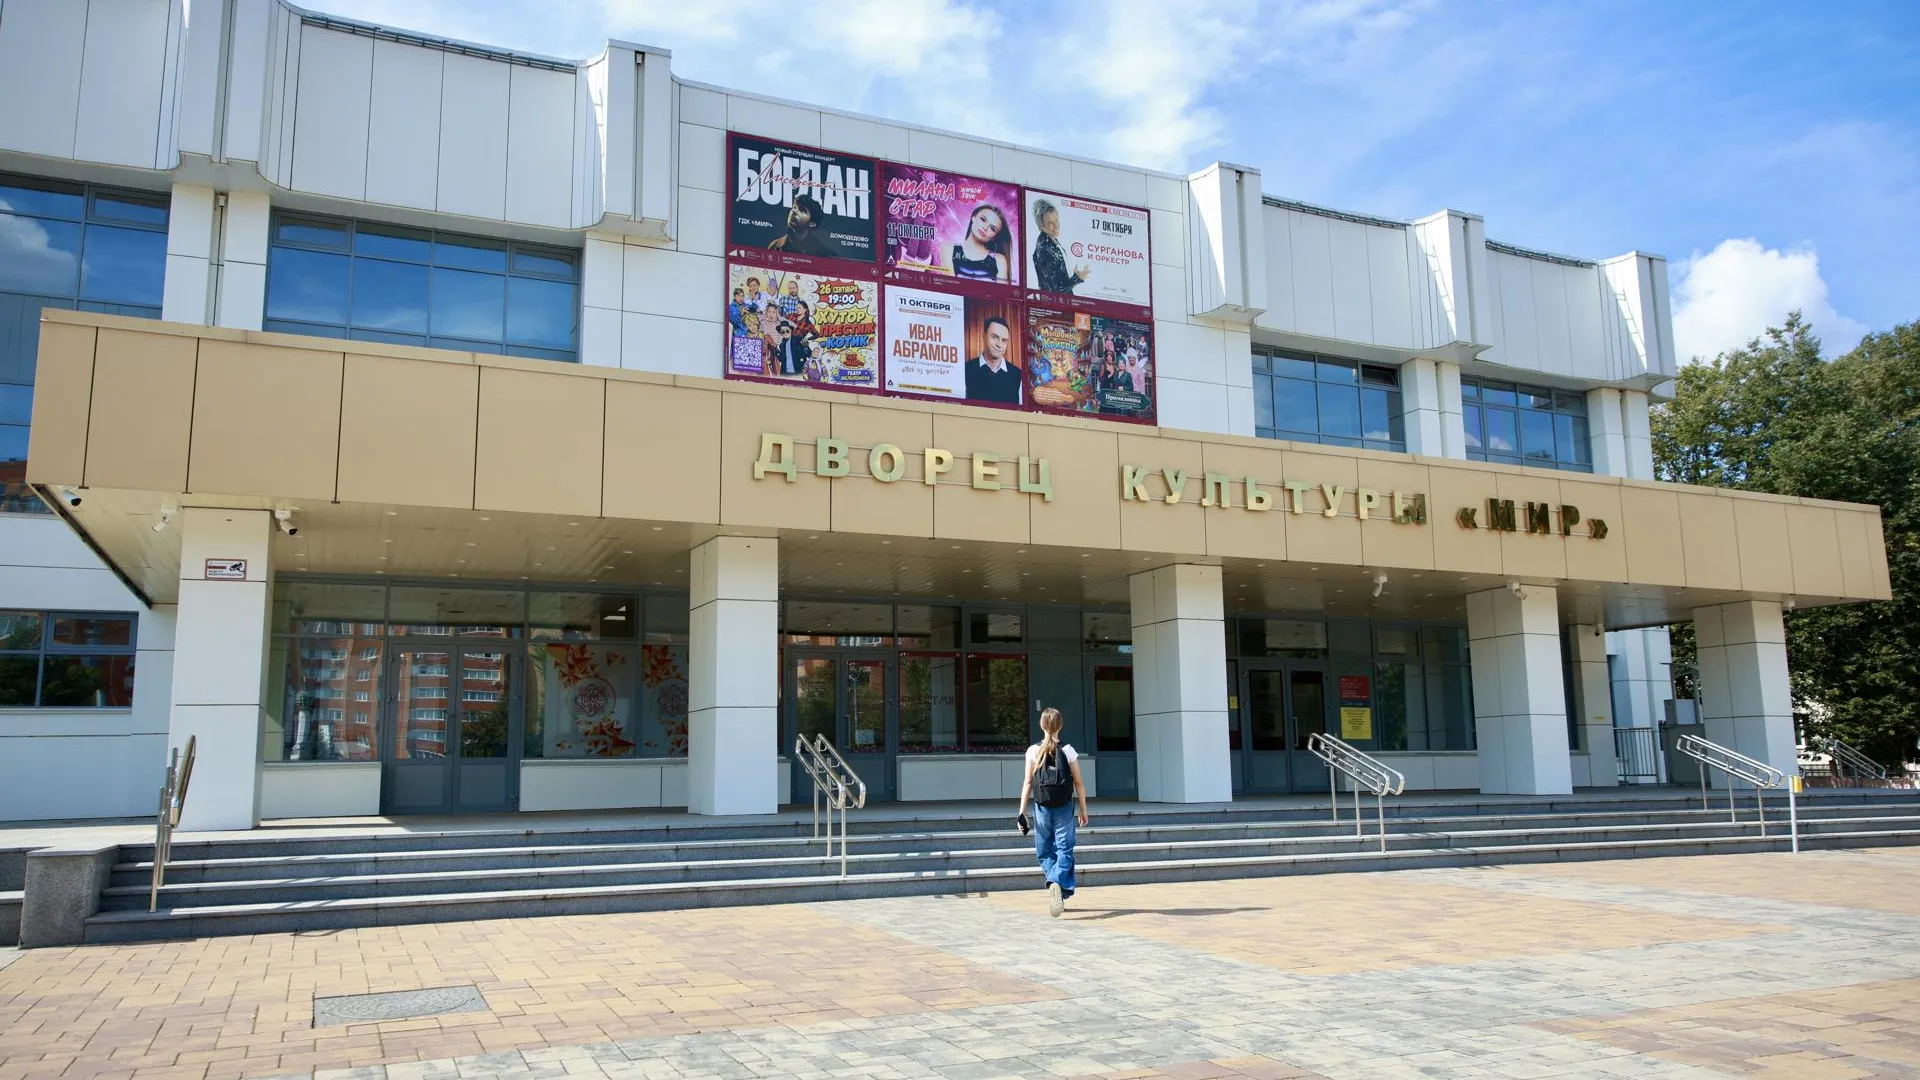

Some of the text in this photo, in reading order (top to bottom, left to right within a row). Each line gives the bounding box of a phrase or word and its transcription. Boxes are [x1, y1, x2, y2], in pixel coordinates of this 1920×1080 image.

[888, 178, 955, 200] МИЛАНА
[889, 197, 936, 218] СТАР
[738, 217, 750, 226] ГДК
[1091, 219, 1100, 230] 17
[1102, 220, 1133, 236] ОКТЯБРЯ
[829, 232, 869, 242] ДОМОДЕДОВО
[897, 223, 935, 241] ОКТЯБРЯ
[1087, 243, 1144, 260] СУРГАНОВА
[1095, 255, 1130, 265] ОРКЕСТР
[819, 284, 858, 295] 26 СЕНТЯБРЯ
[828, 294, 856, 304] 19:00
[899, 297, 951, 312] 11 ОКТЯБРЯ
[817, 310, 867, 325] ХУТОР
[820, 322, 876, 337] ПРЕСТИЖ
[909, 322, 942, 342] ИВАН
[826, 335, 869, 349] КОТИК
[893, 339, 958, 364] АБРАМОВ
[753, 432, 1609, 540] ДВОРЕЦ КУЛЬТУРЫ «МИР»
